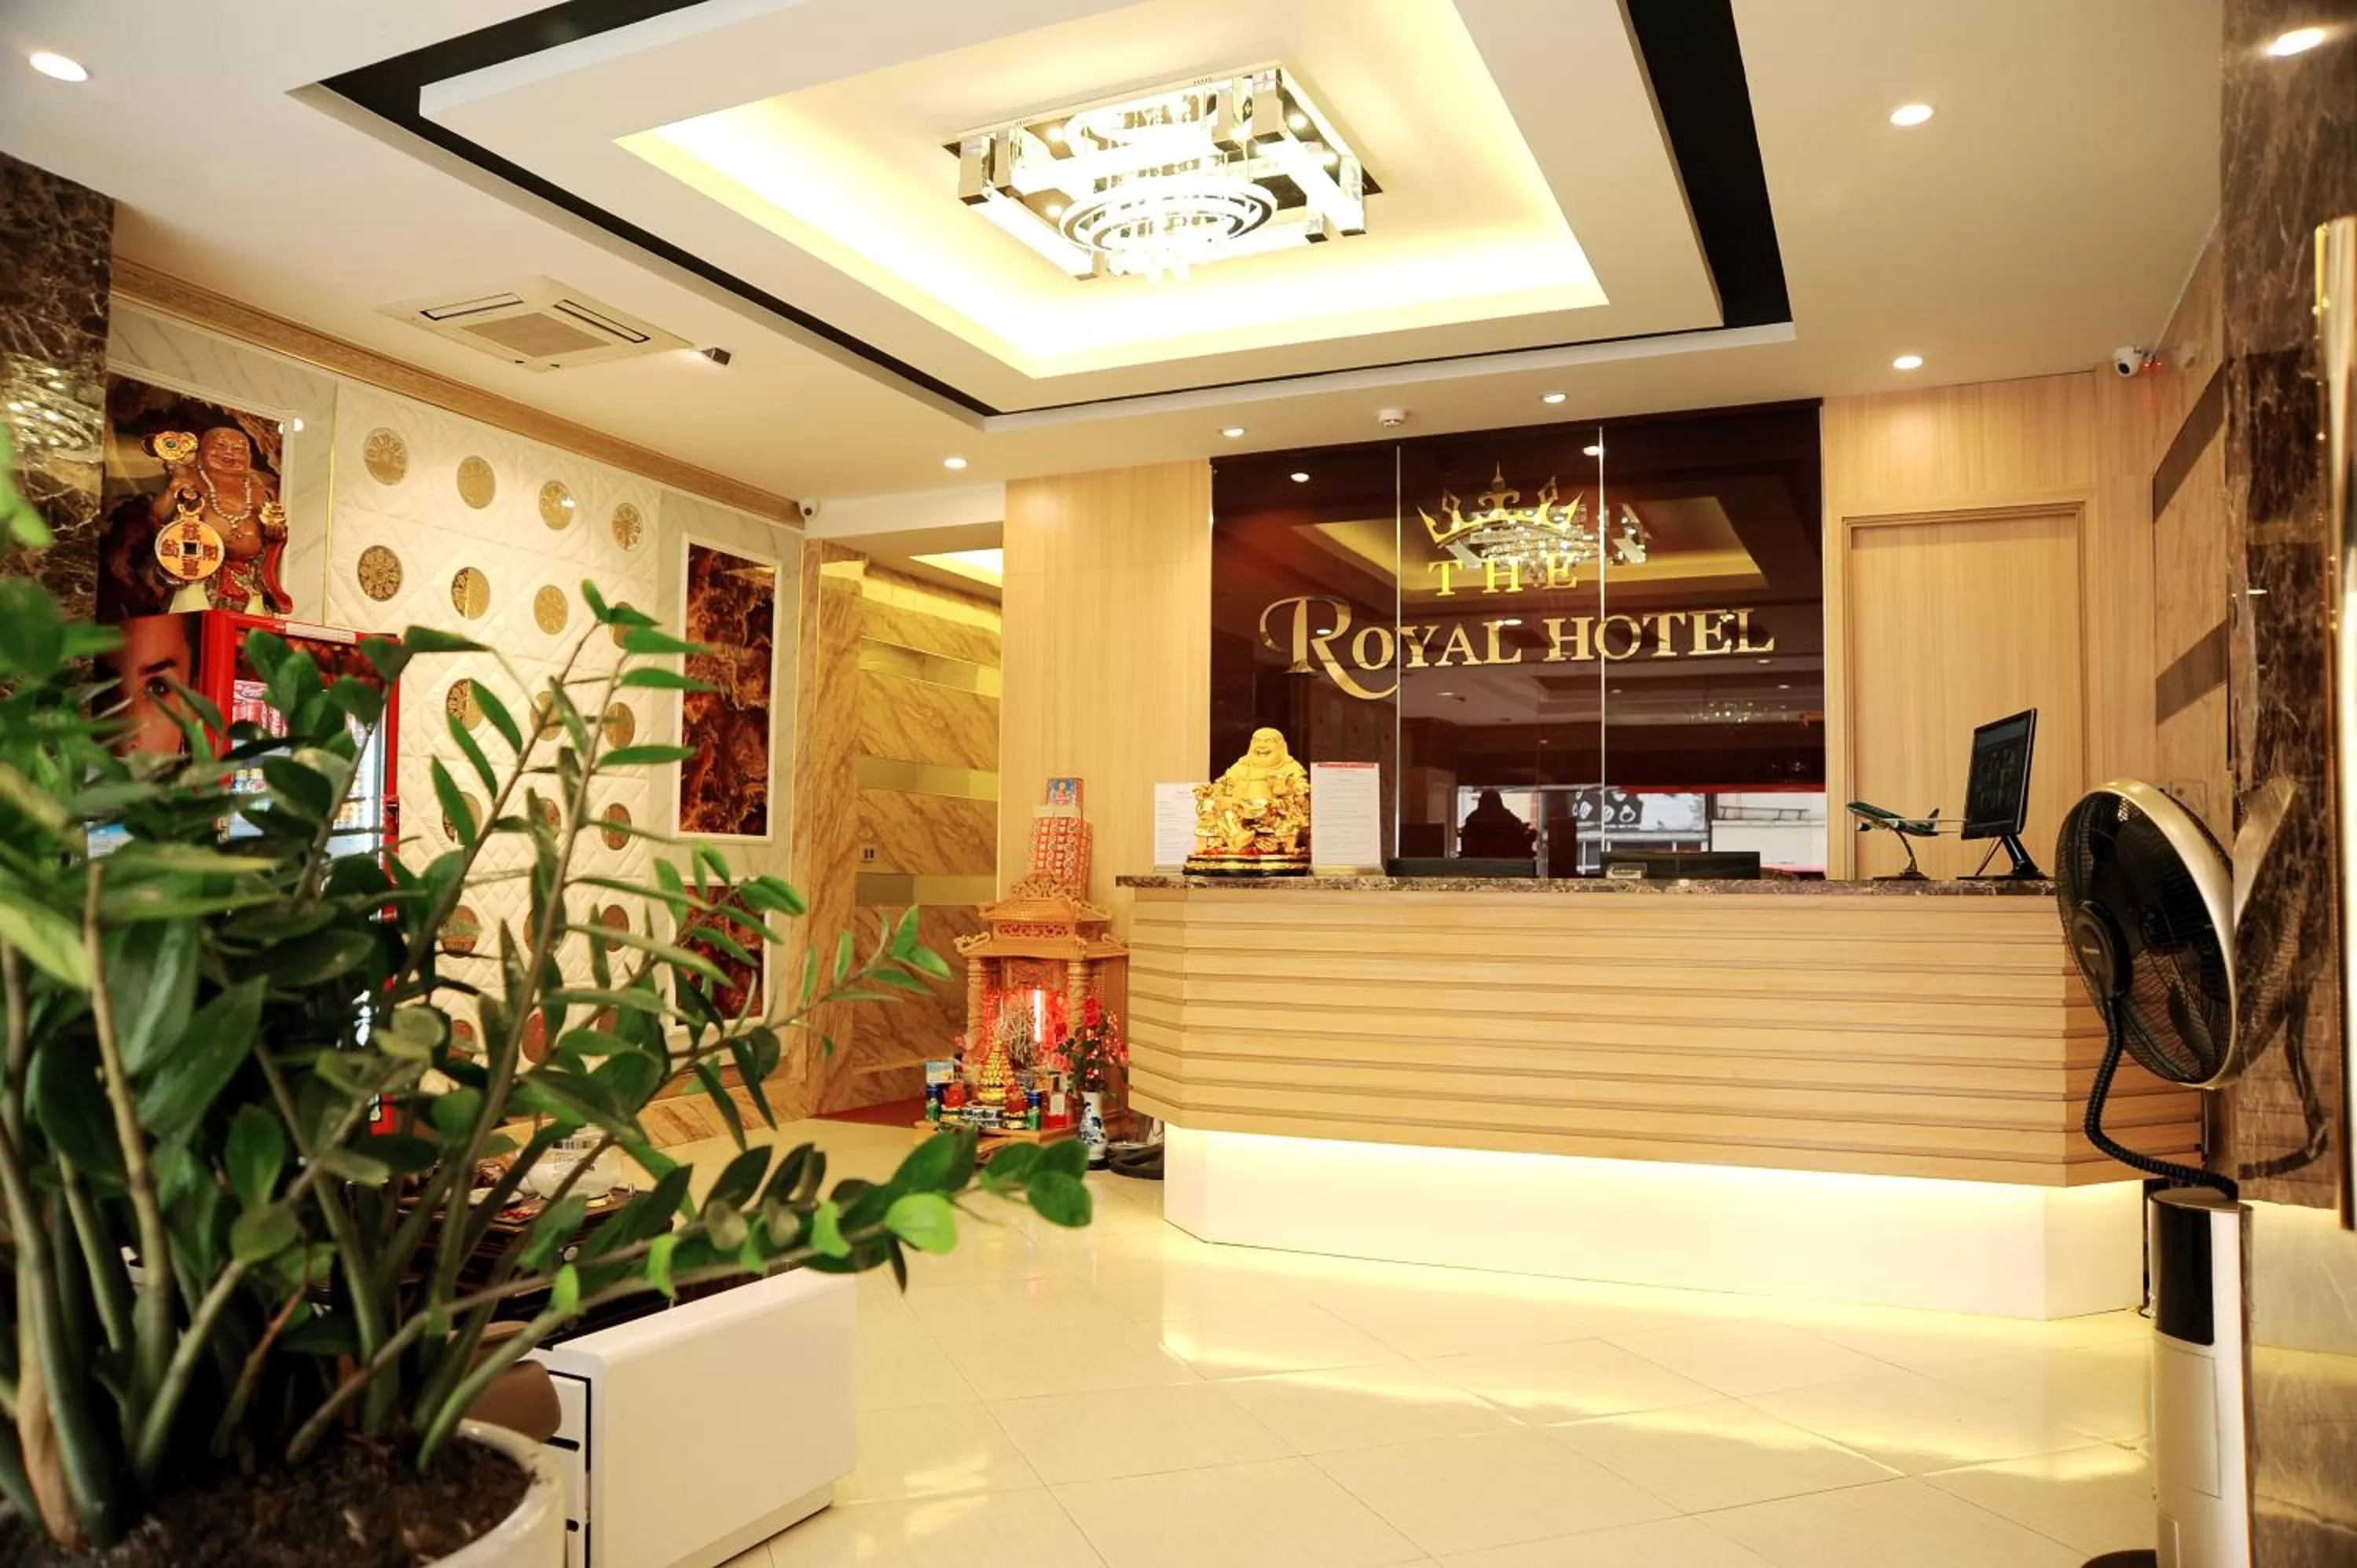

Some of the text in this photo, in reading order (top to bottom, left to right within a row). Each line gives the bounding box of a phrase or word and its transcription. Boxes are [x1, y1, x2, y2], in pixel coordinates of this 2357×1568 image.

[1428, 552, 1577, 597] THE
[1259, 595, 1776, 700] ROYAL HOTEL
